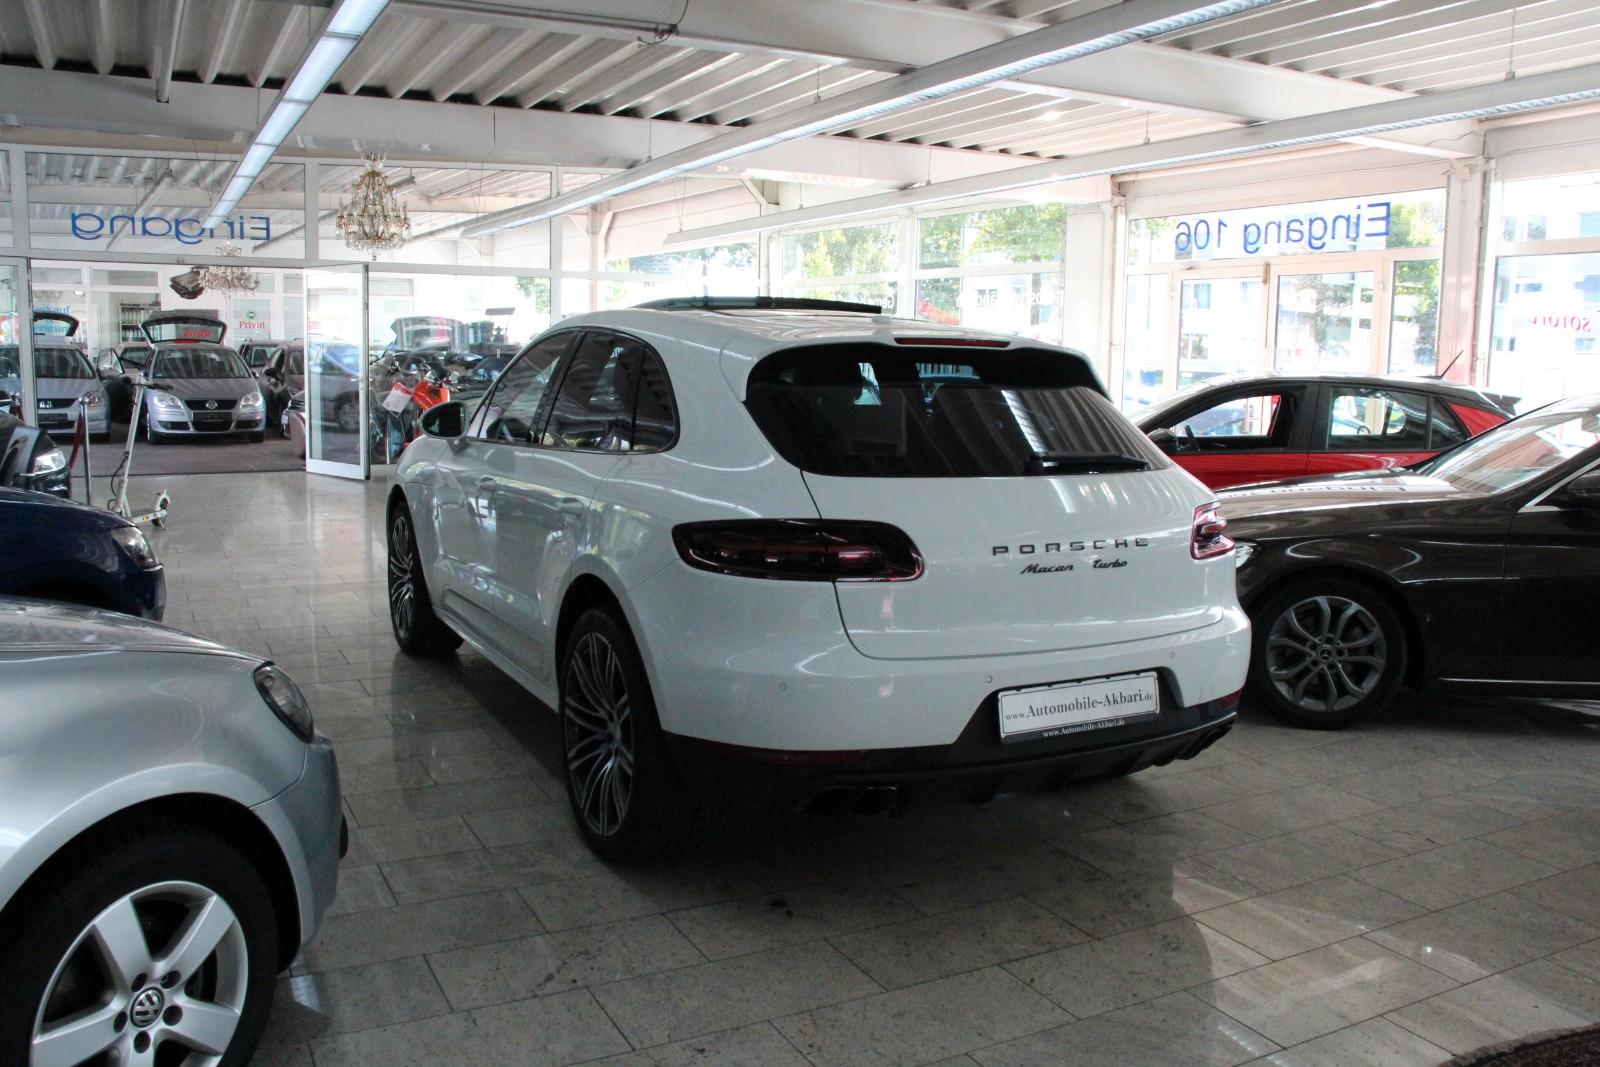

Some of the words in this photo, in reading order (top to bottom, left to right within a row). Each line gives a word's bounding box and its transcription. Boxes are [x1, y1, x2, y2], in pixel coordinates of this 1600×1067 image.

[239, 320, 266, 329] Privat
[992, 537, 1149, 557] PORSCHE
[1020, 563, 1074, 575] Macan
[1005, 689, 1154, 721] www.Automobile-Akbari.de
[1043, 718, 1126, 737] www.Automobile-Akbari.de
